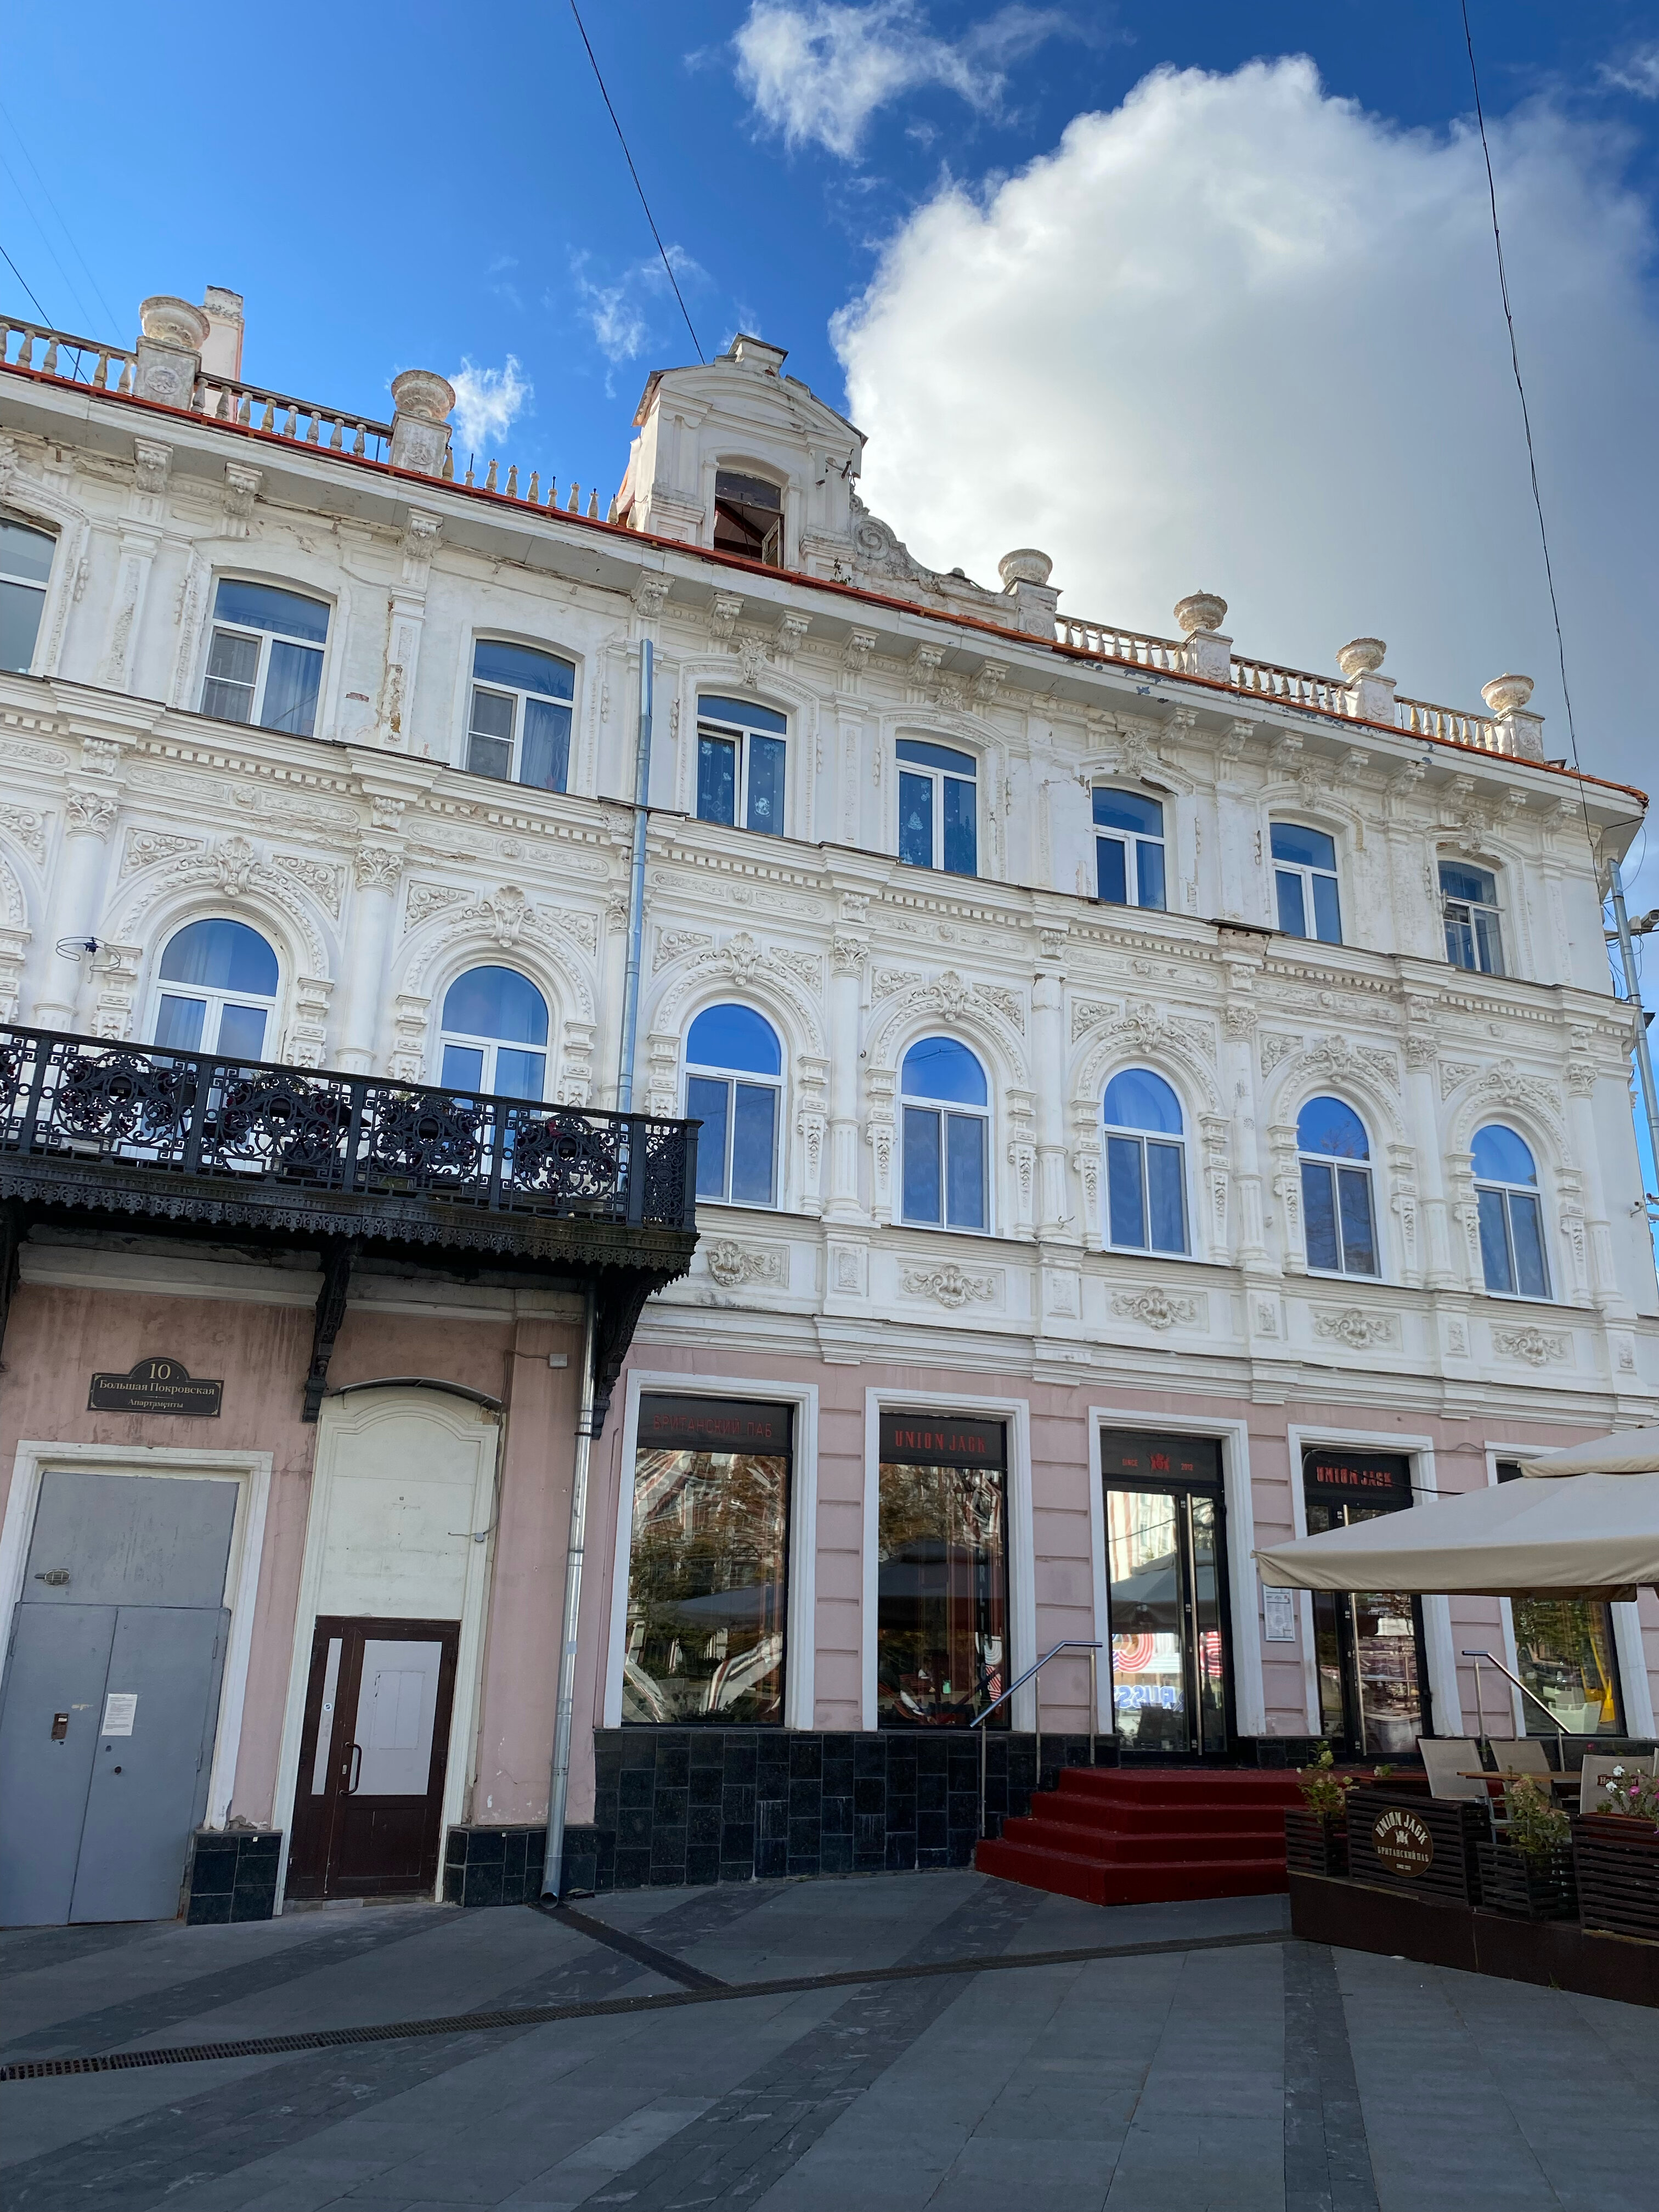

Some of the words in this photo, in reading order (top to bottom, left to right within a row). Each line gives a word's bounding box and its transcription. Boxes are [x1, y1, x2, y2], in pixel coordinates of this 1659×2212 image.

[149, 1363, 171, 1380] 10
[99, 1380, 148, 1391] Большая
[150, 1383, 215, 1396] Покровская
[127, 1399, 183, 1409] Апартаменты
[653, 1414, 741, 1435] БРИТАНСКИЙ
[747, 1421, 772, 1438] ПАБ
[894, 1430, 944, 1450] UNION
[949, 1435, 986, 1453] JACK
[1316, 1466, 1359, 1485] UNION
[1375, 1812, 1402, 1837] UNION
[1403, 1814, 1428, 1845] JACK
